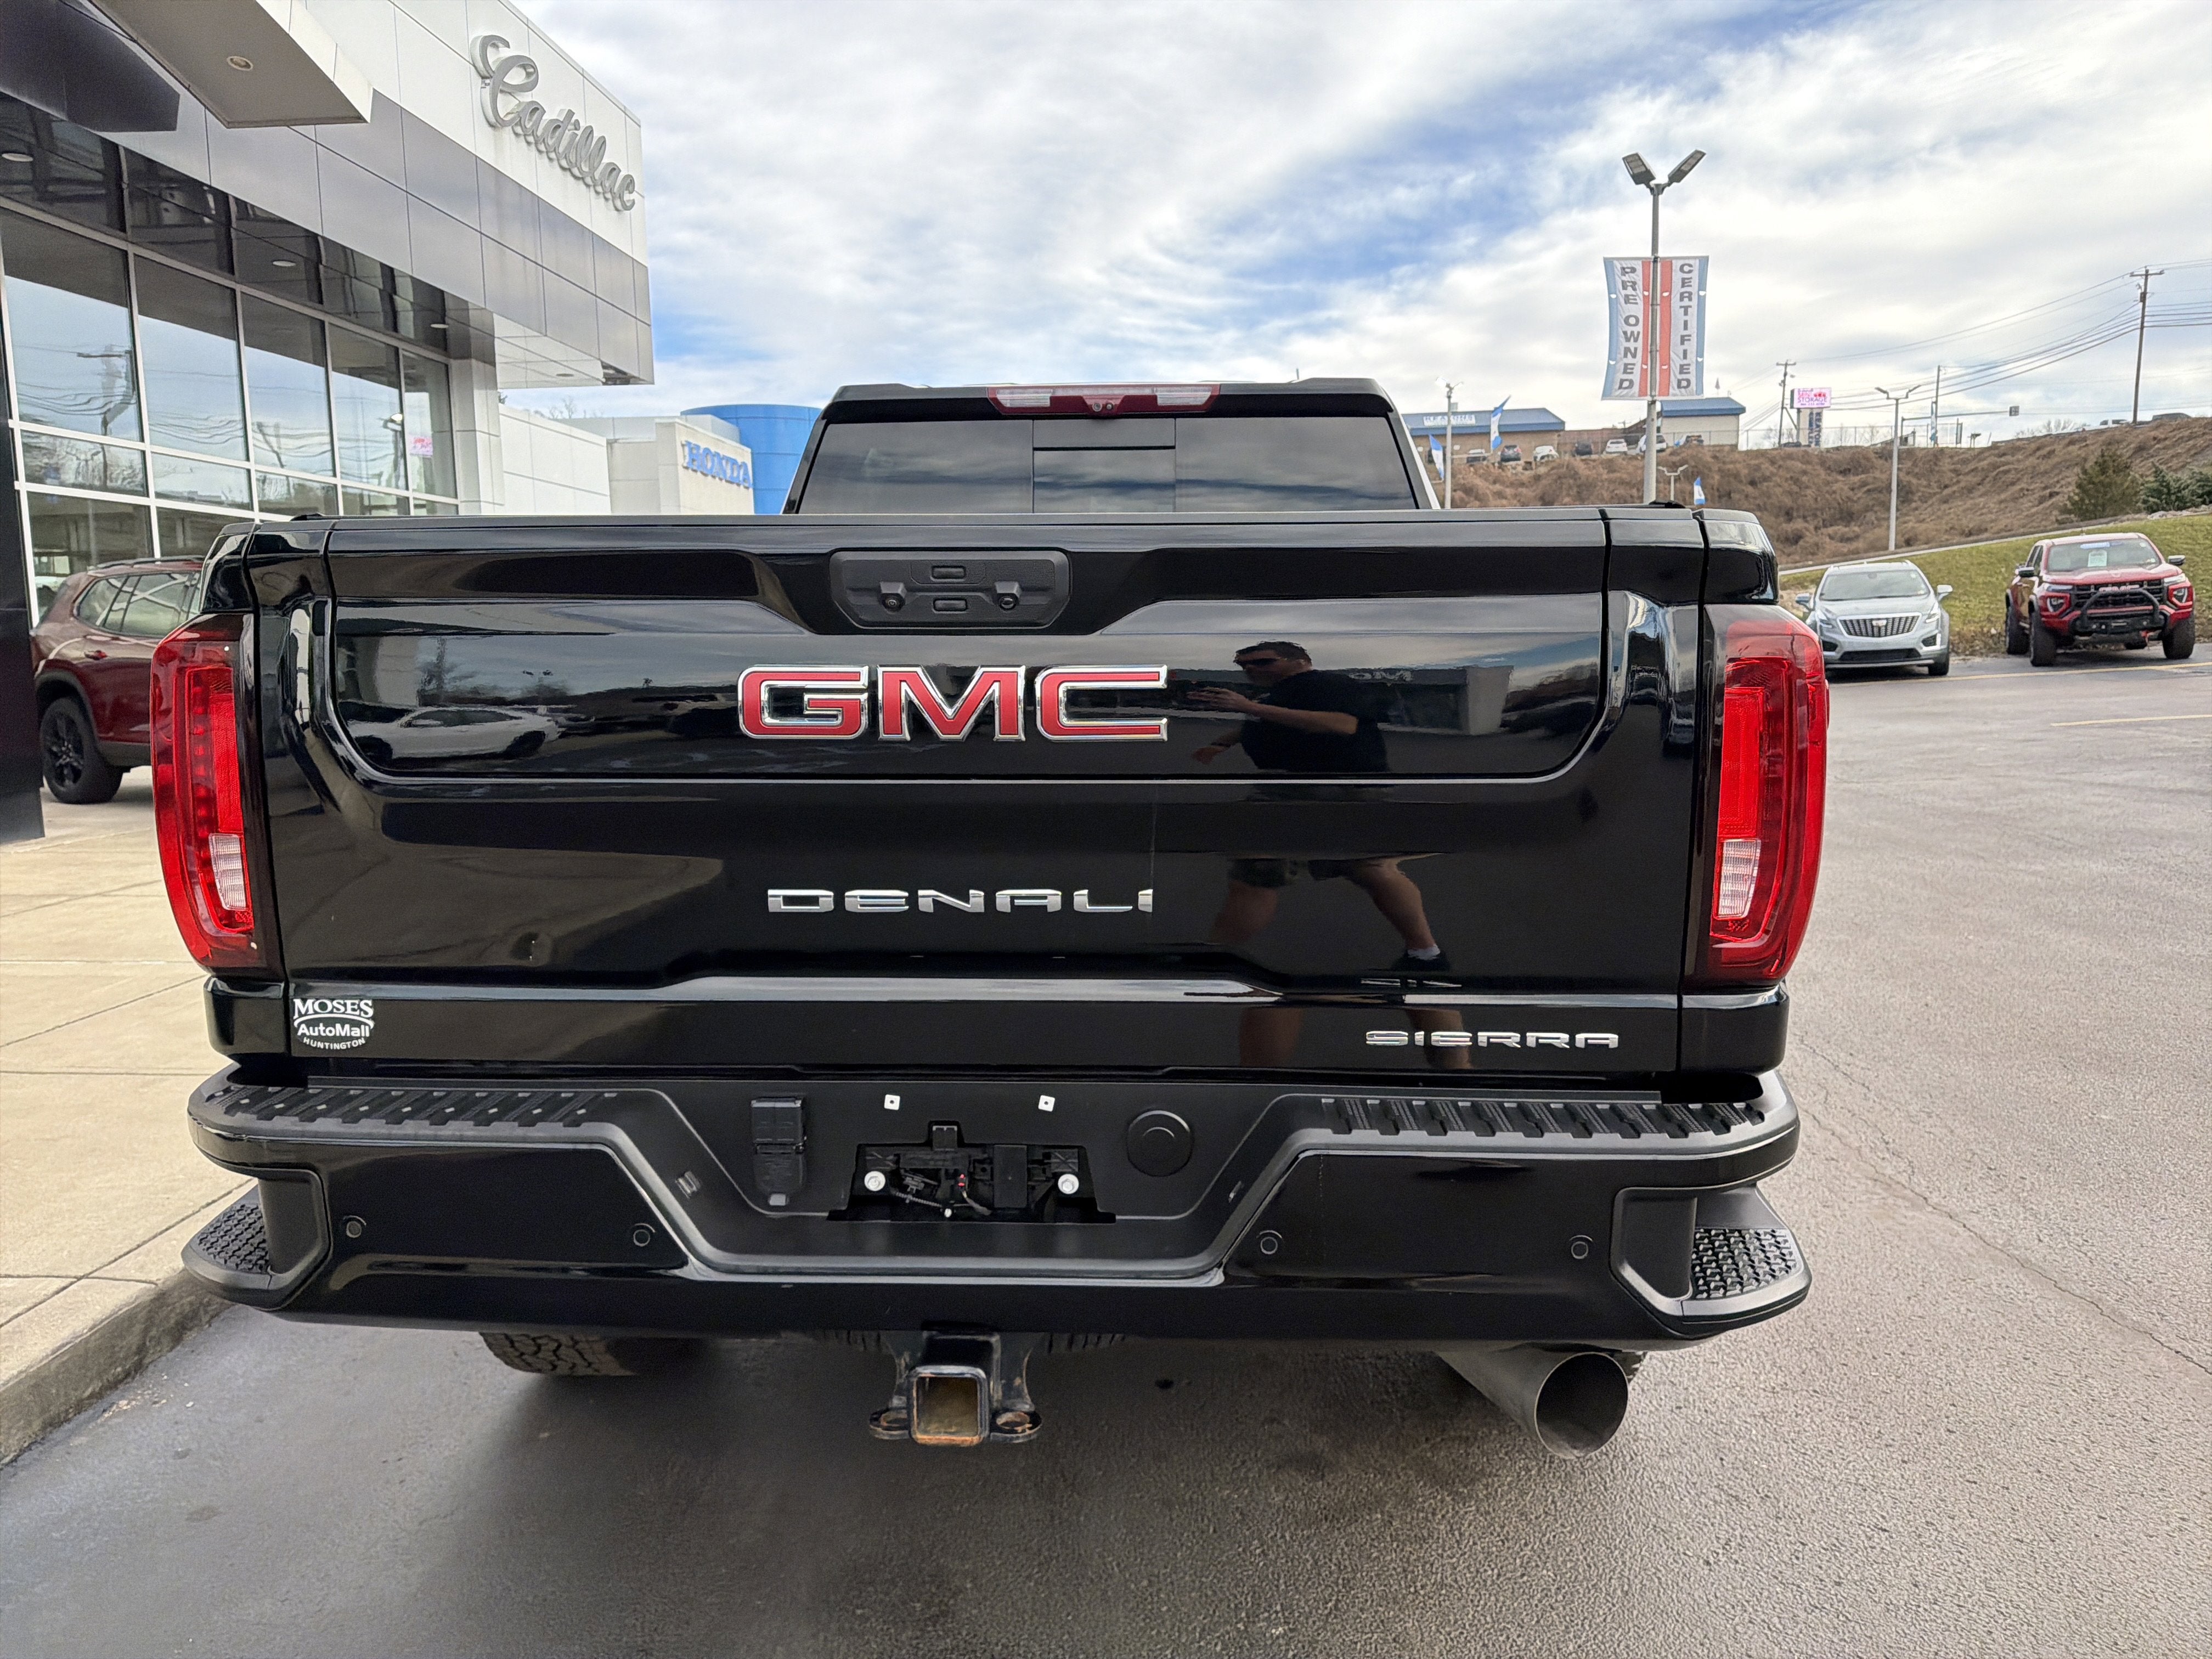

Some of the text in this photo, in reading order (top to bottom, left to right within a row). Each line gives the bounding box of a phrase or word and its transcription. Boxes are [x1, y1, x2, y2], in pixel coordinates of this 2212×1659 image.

[471, 35, 635, 211] Cadillac
[1618, 266, 1640, 390] PRE OWNED
[1677, 263, 1694, 390] CERTIFIED
[681, 439, 753, 489] HONDA
[737, 664, 1168, 742] GMC
[768, 889, 1154, 913] DENALI
[293, 998, 374, 1020] MOSES
[297, 1023, 370, 1037] AutoMall
[303, 1036, 366, 1050] HUNTINGTON
[1365, 1030, 1619, 1048] SIERRA
